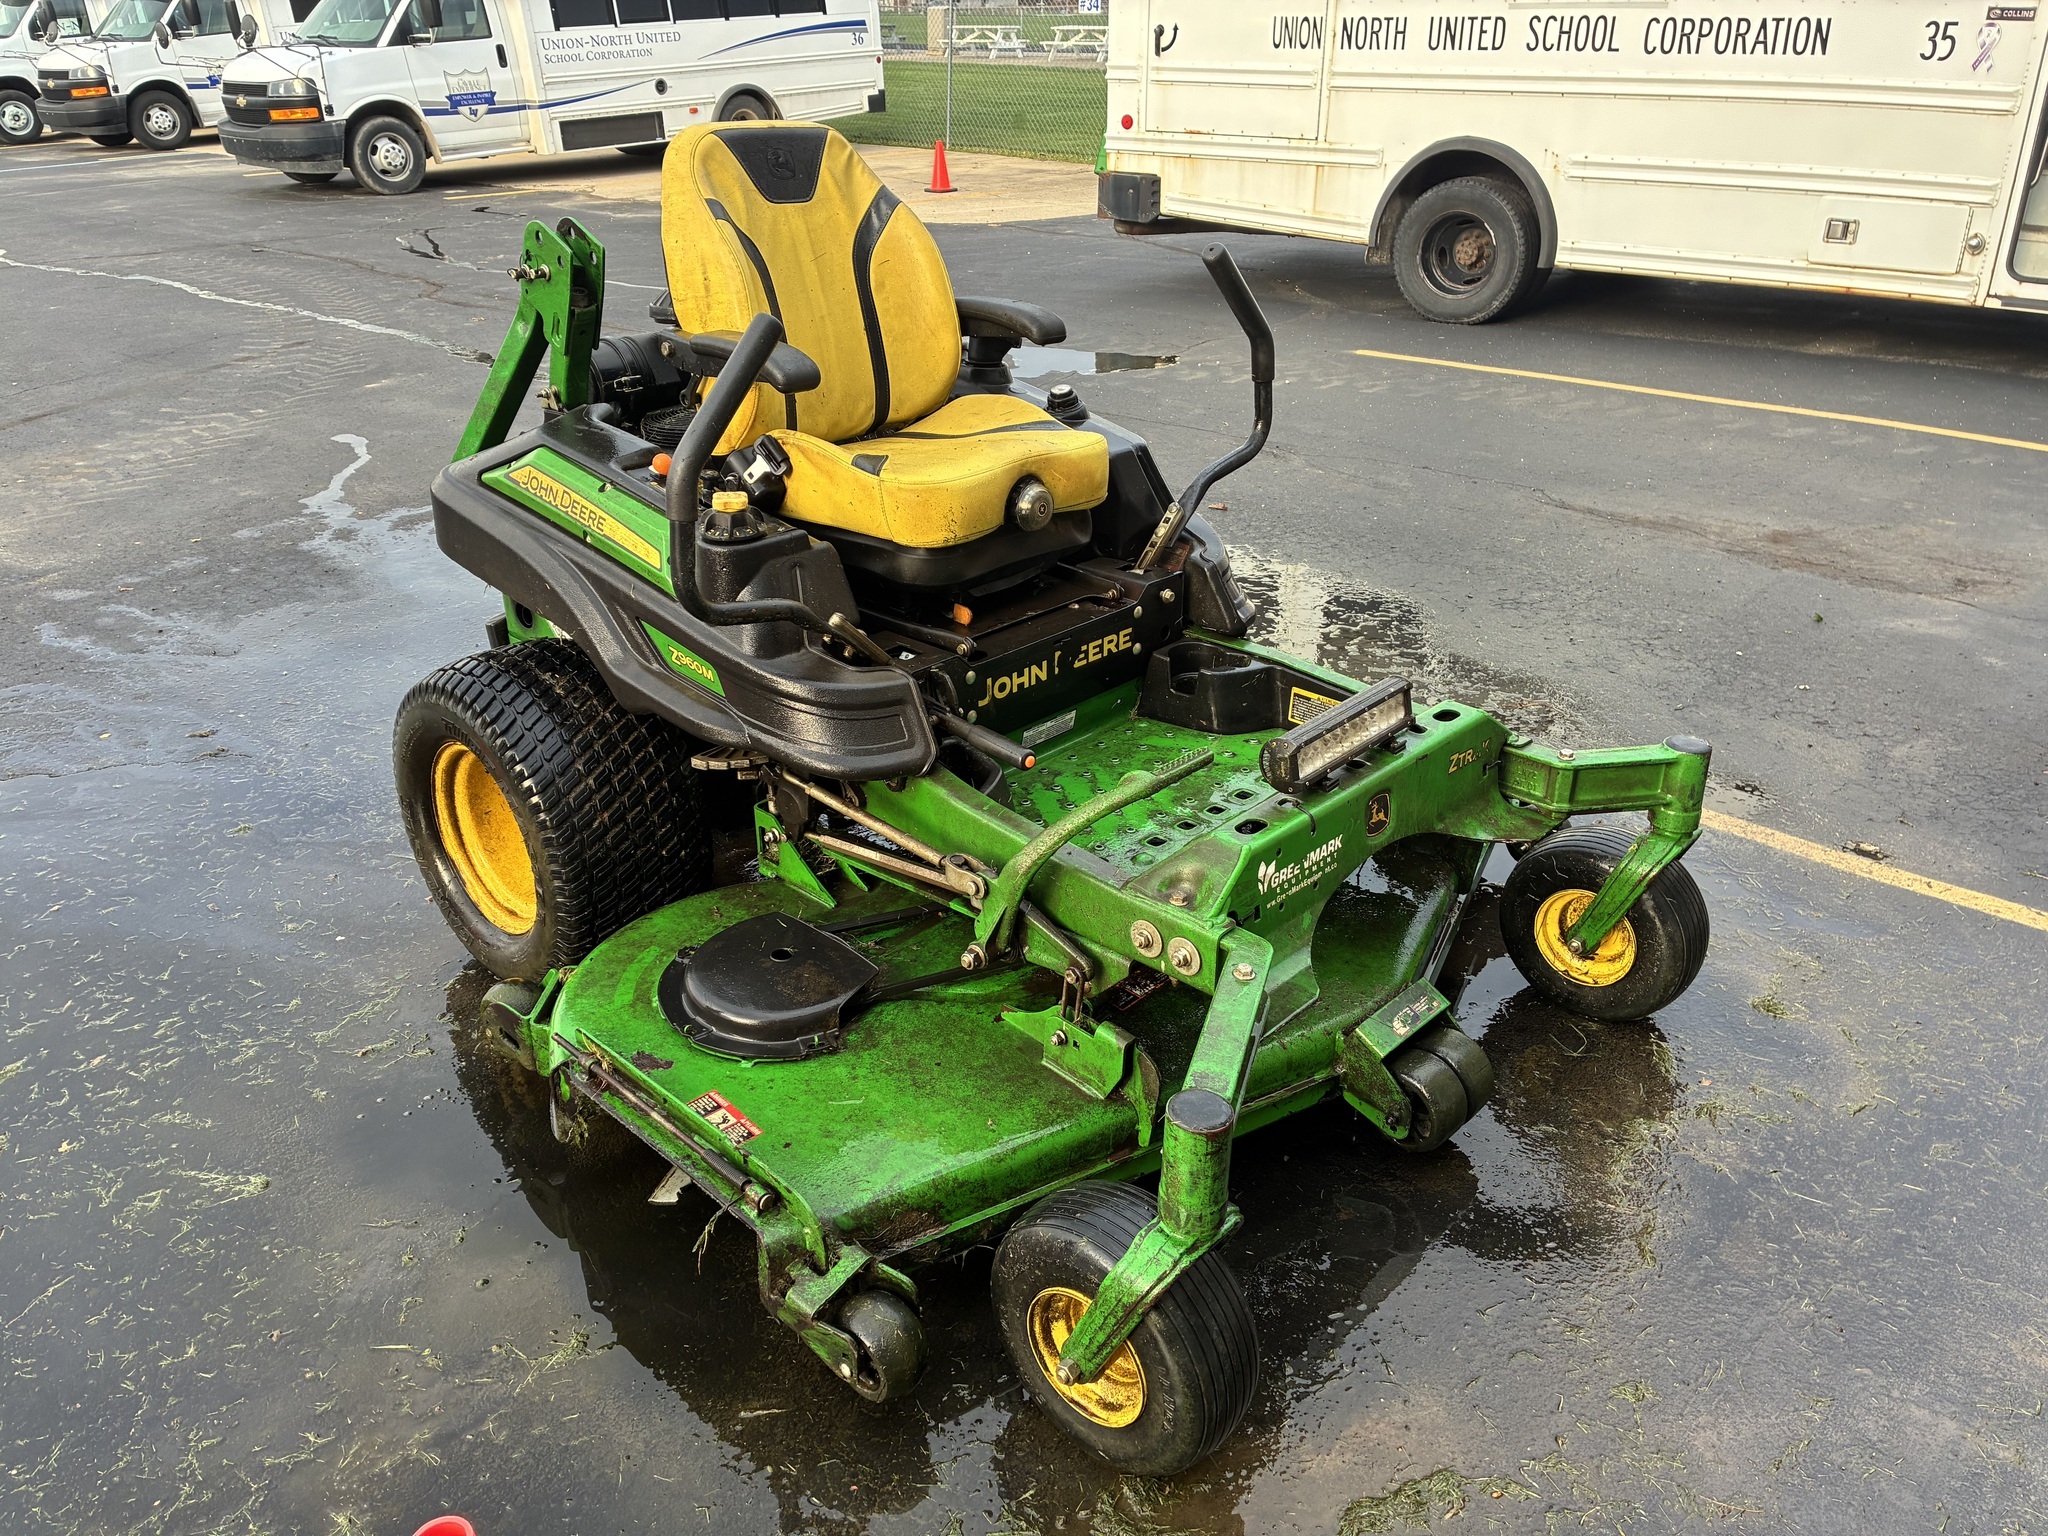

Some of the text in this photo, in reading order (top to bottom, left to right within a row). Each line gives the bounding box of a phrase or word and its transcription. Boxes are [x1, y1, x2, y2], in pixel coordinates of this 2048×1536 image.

[2002, 10, 2034, 18] COLLINS
[636, 31, 681, 44] UNITED
[851, 32, 864, 46] 36
[1272, 15, 1833, 56] UNION NORTH UNITED SCHOOL CORPORATION
[1919, 20, 1959, 62] 35
[544, 48, 653, 64] SCHOOL CORPORATION
[521, 469, 607, 533] JOHN DEERE
[667, 644, 715, 684] Z960M
[978, 660, 1048, 708] JOHN
[1448, 737, 1491, 775] ZTR
[1276, 852, 1338, 893] EQUIPMENT
